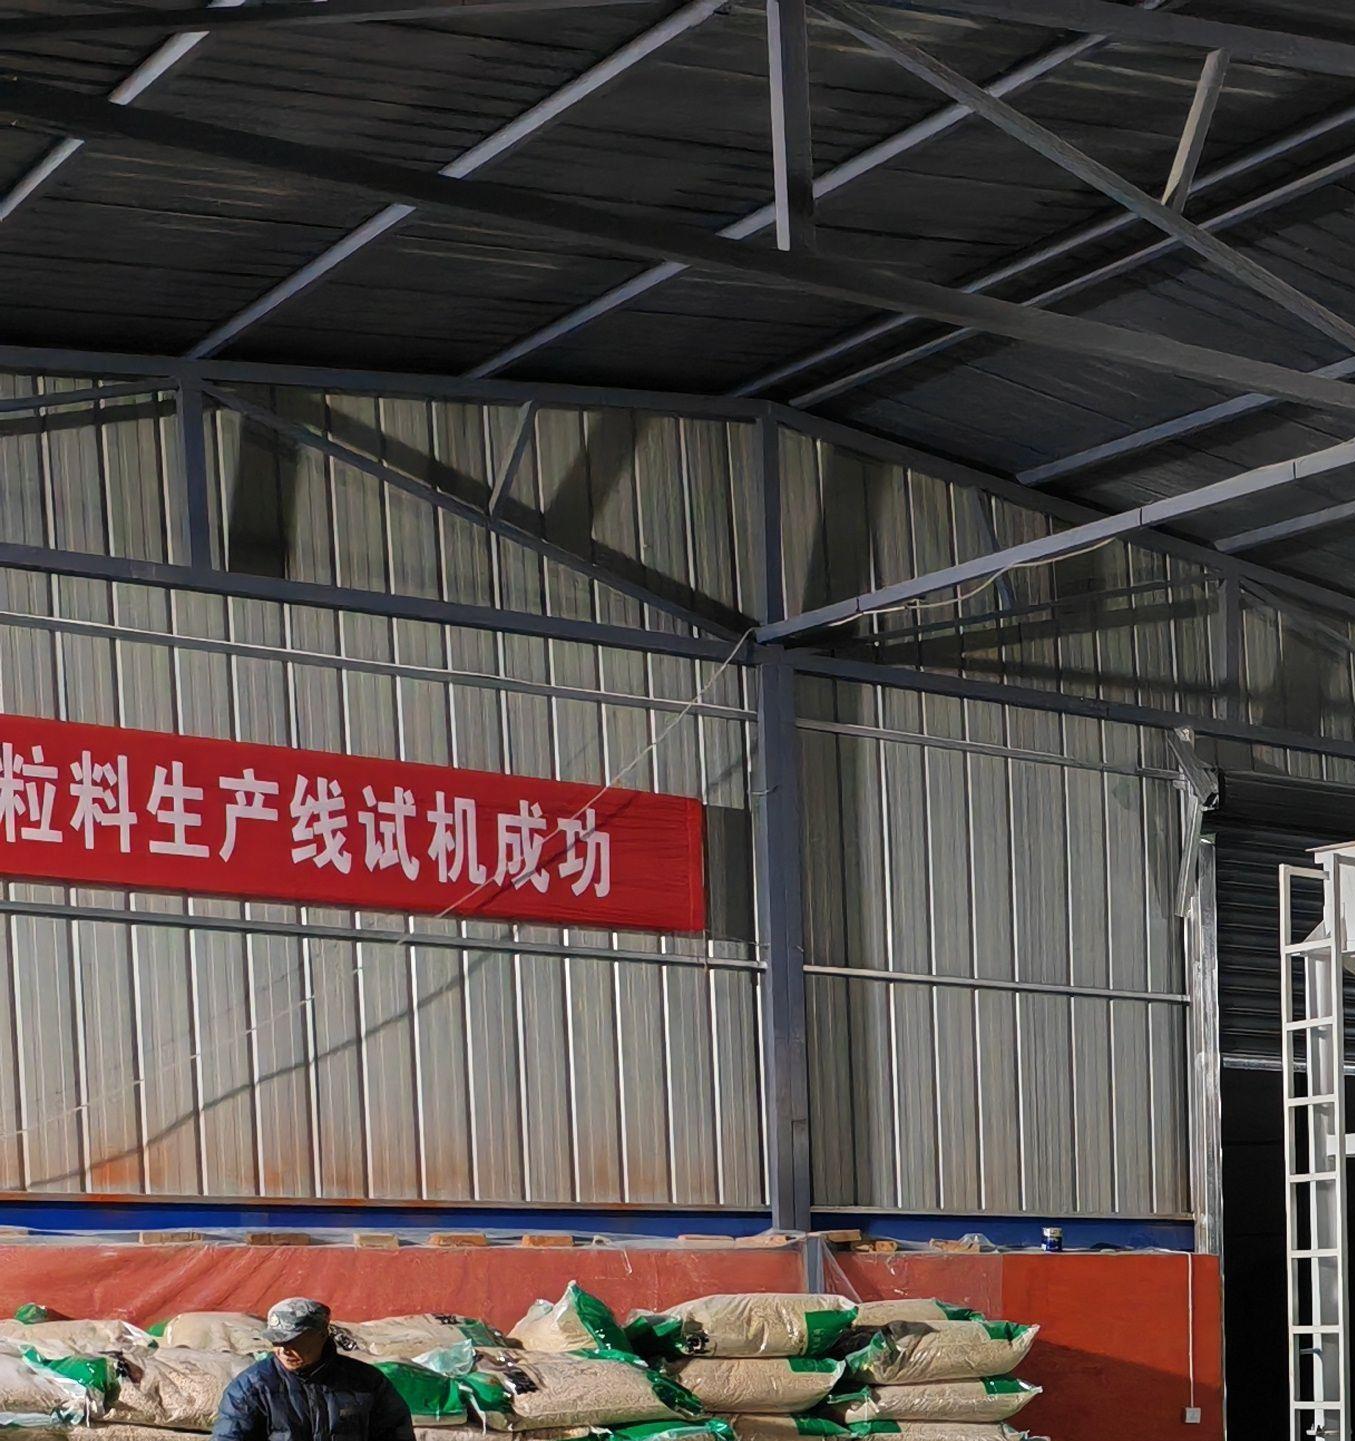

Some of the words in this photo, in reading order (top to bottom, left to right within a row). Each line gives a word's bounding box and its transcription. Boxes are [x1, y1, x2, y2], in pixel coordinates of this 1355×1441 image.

[0, 742, 611, 898] 粒料生产线试机成功
